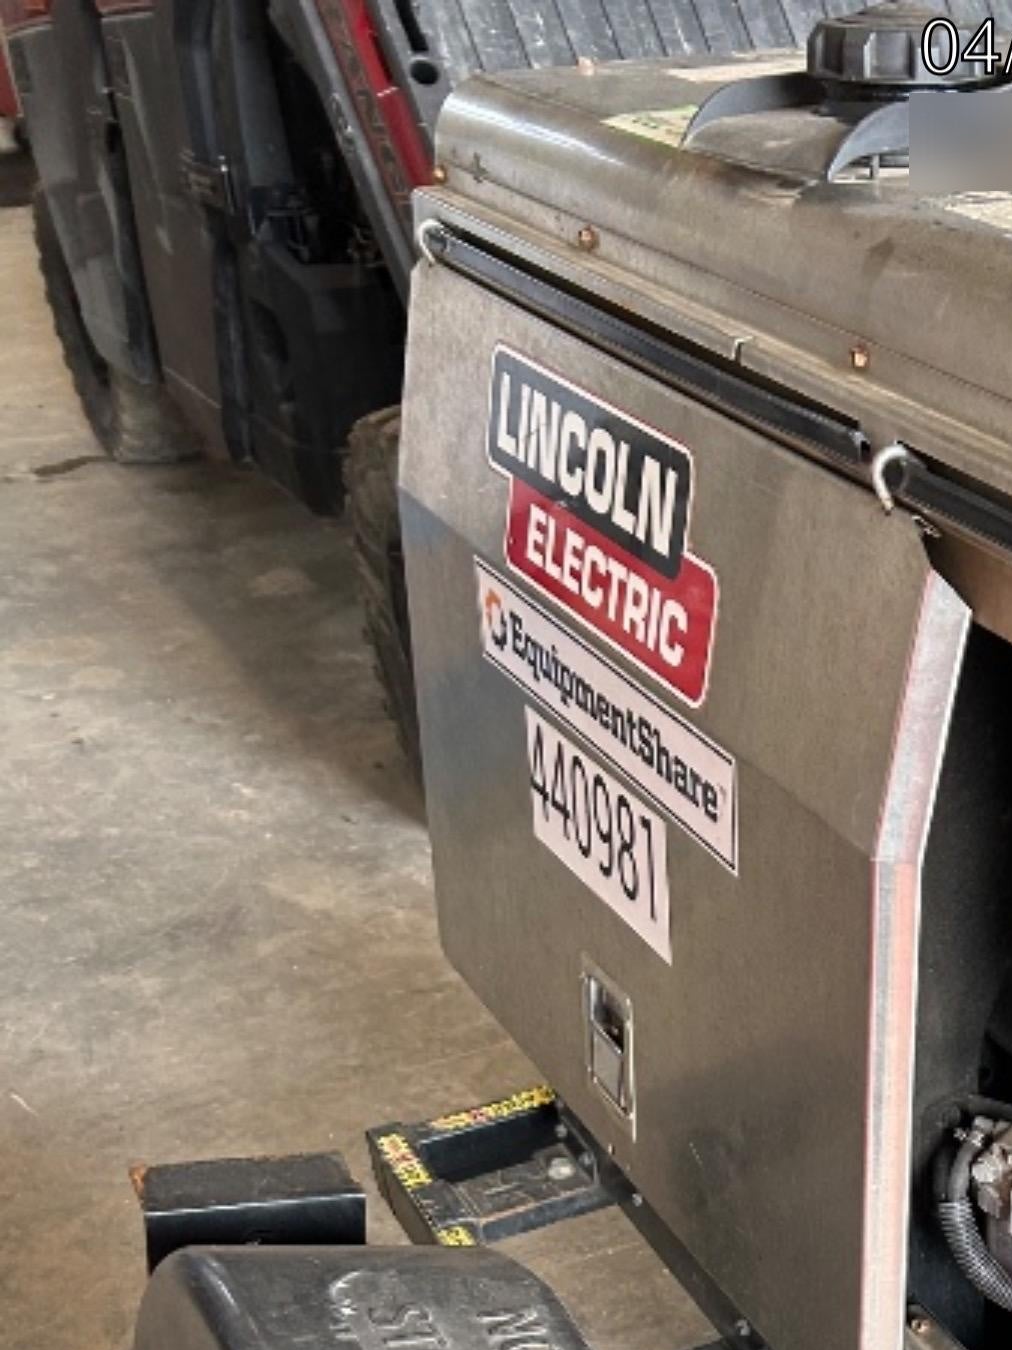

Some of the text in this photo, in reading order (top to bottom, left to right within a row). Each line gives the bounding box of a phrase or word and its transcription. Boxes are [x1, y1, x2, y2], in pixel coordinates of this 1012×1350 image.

[497, 371, 679, 558] LINCOLN
[526, 502, 688, 667] ELECTRIC
[508, 611, 719, 824] EquipmentShare
[530, 722, 658, 923] 440981
